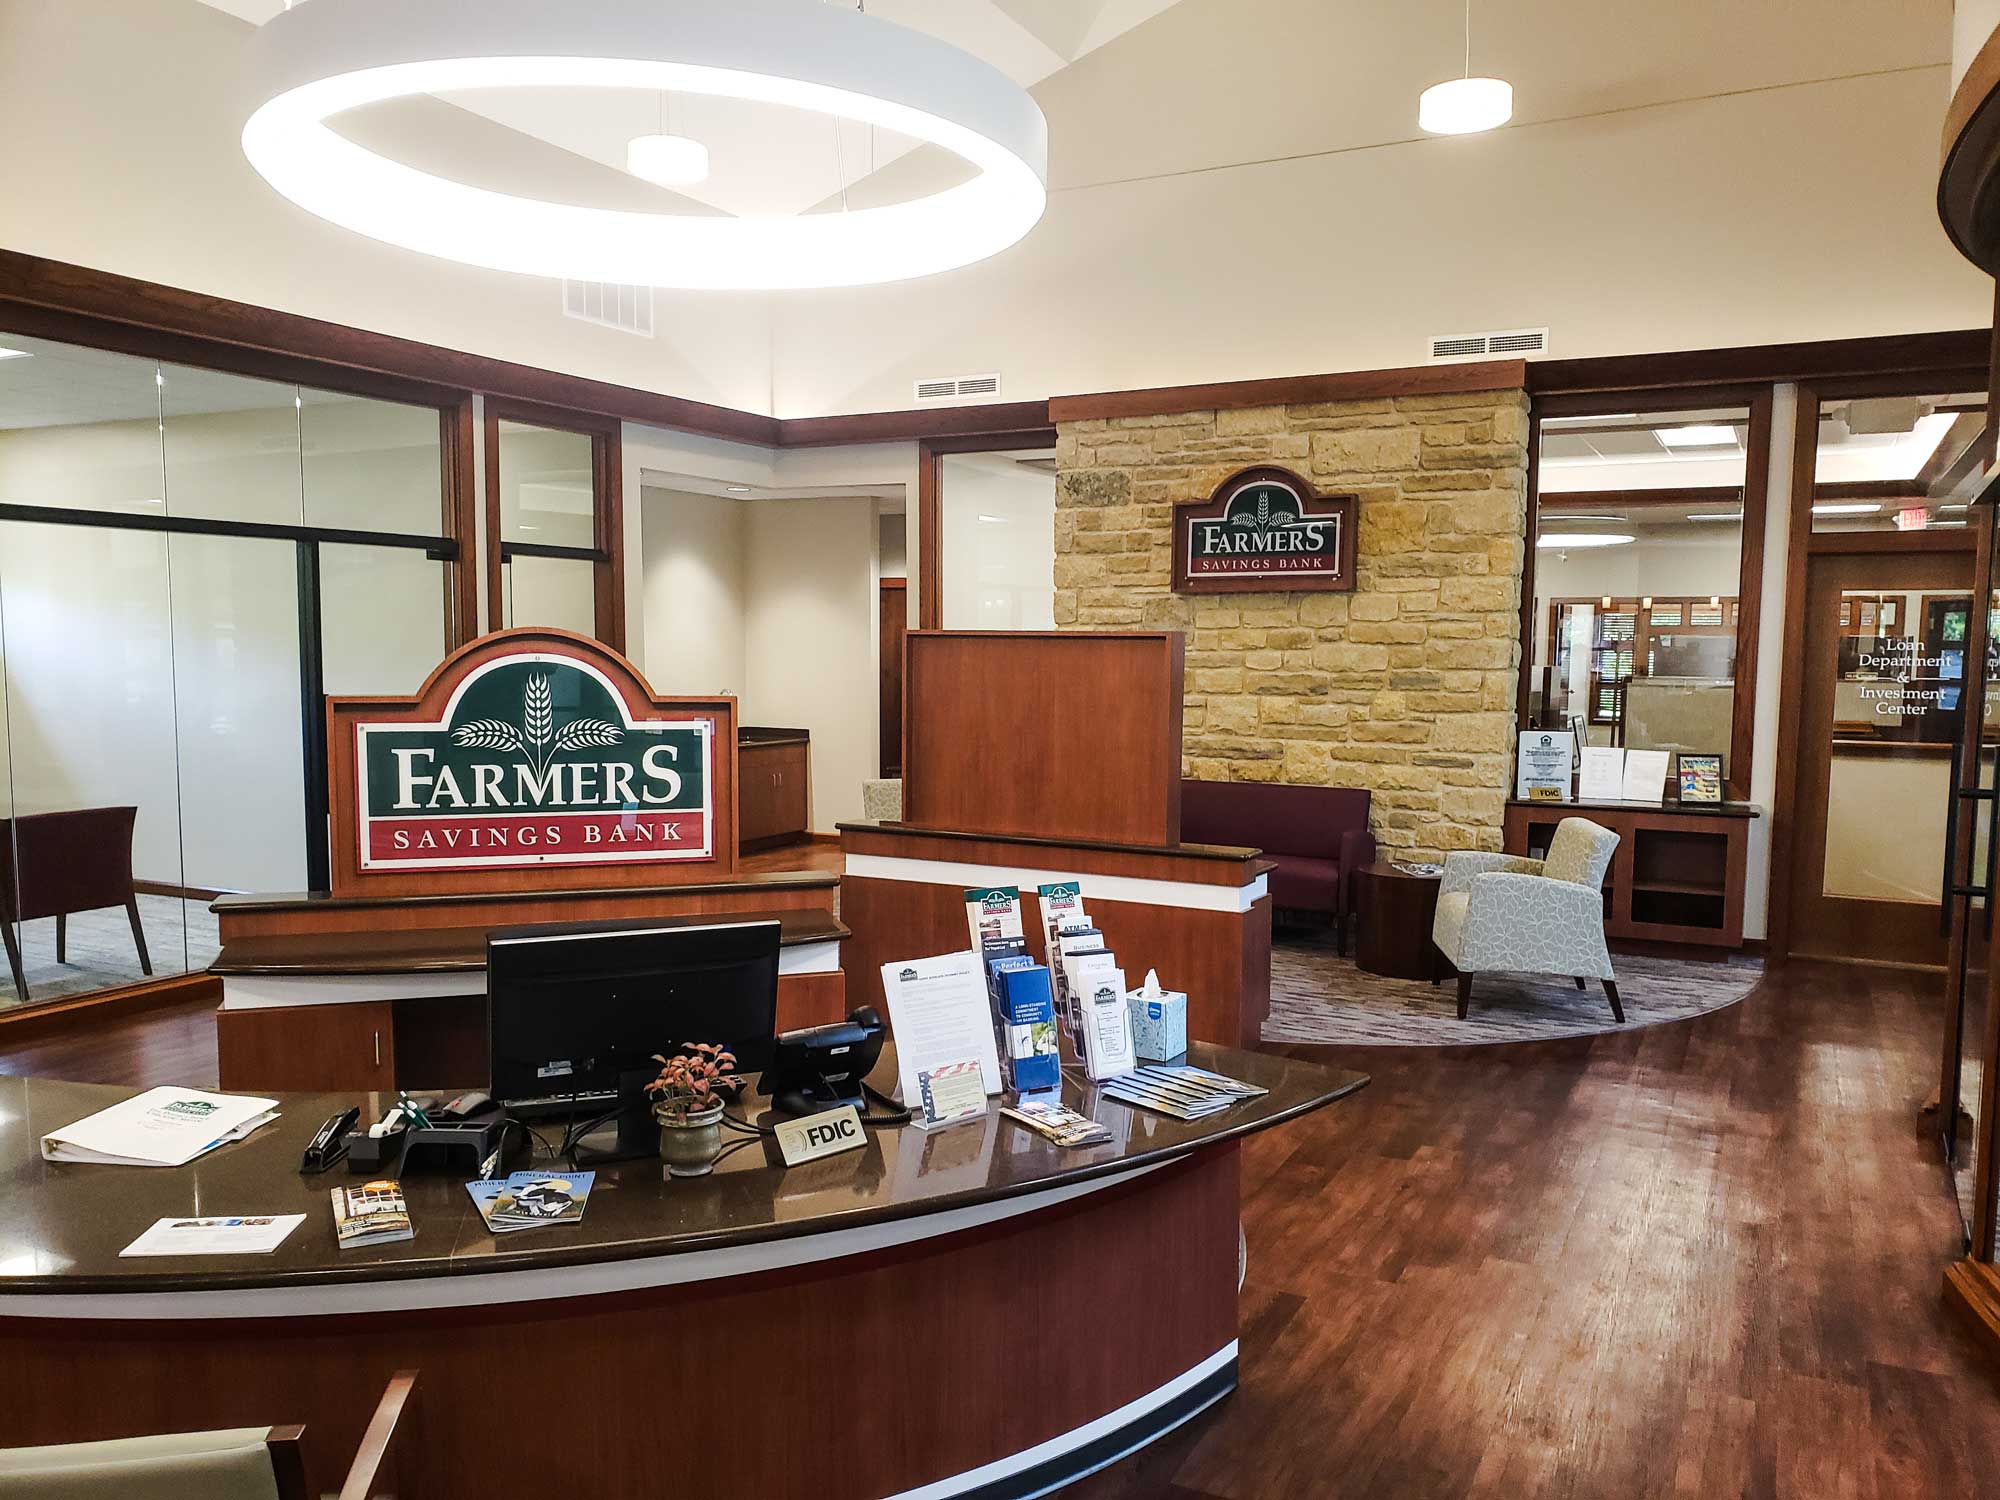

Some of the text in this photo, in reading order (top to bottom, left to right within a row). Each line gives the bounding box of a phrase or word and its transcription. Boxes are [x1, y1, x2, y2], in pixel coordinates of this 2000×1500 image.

[1202, 523, 1325, 554] FARMERS
[1202, 557, 1323, 570] SAVINGS BANK
[1887, 639, 1925, 651] Loan
[1859, 655, 1952, 670] Department
[1897, 671, 1910, 683] &
[1860, 687, 1946, 700] Investment
[1876, 702, 1927, 715] Center
[391, 744, 683, 810] FARMERS
[1540, 789, 1559, 797] FDIC
[393, 822, 683, 850] SAVINGS BANK
[983, 901, 1011, 911] FARMERS
[1063, 924, 1080, 932] ATM
[806, 1118, 856, 1147] FDIC
